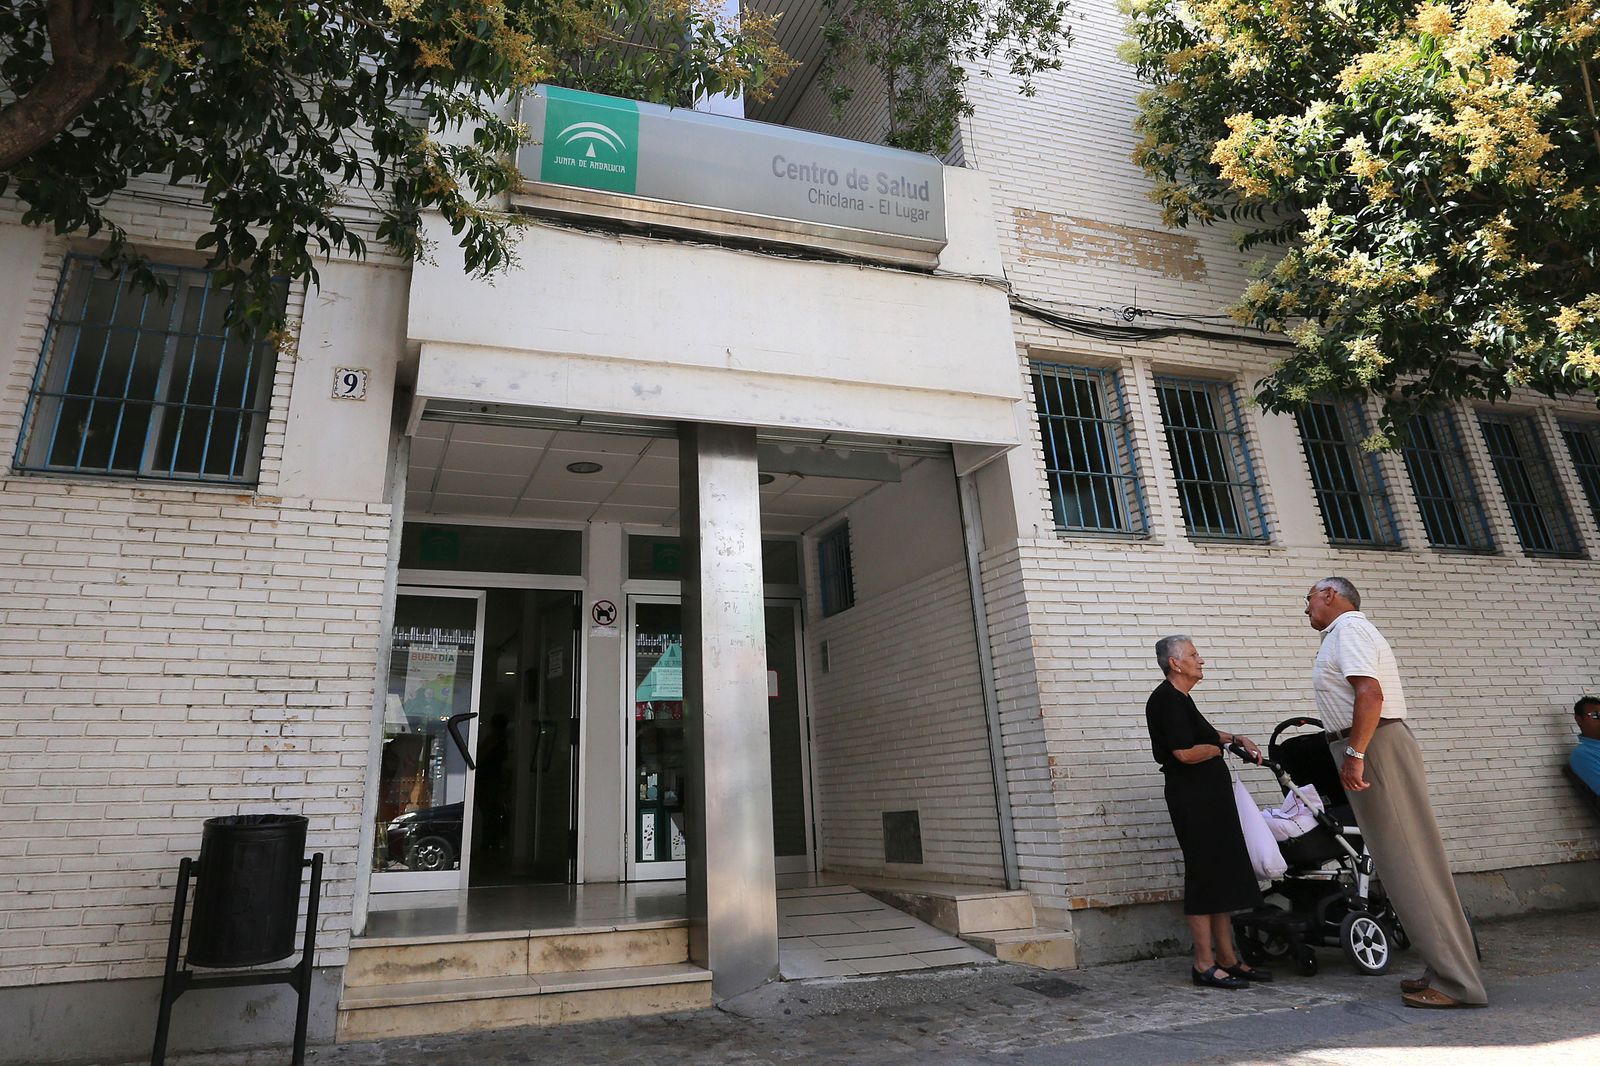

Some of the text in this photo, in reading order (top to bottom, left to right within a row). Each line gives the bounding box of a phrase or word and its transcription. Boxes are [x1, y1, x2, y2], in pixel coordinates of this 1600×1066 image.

[554, 156, 576, 166] JUNTA
[579, 159, 587, 167] DE
[772, 154, 930, 202] Centro de Salud
[808, 187, 864, 211] Chiclana
[879, 199, 890, 215] El
[896, 202, 930, 223] Lugar
[343, 373, 358, 394] 9
[411, 652, 437, 661] BUEN
